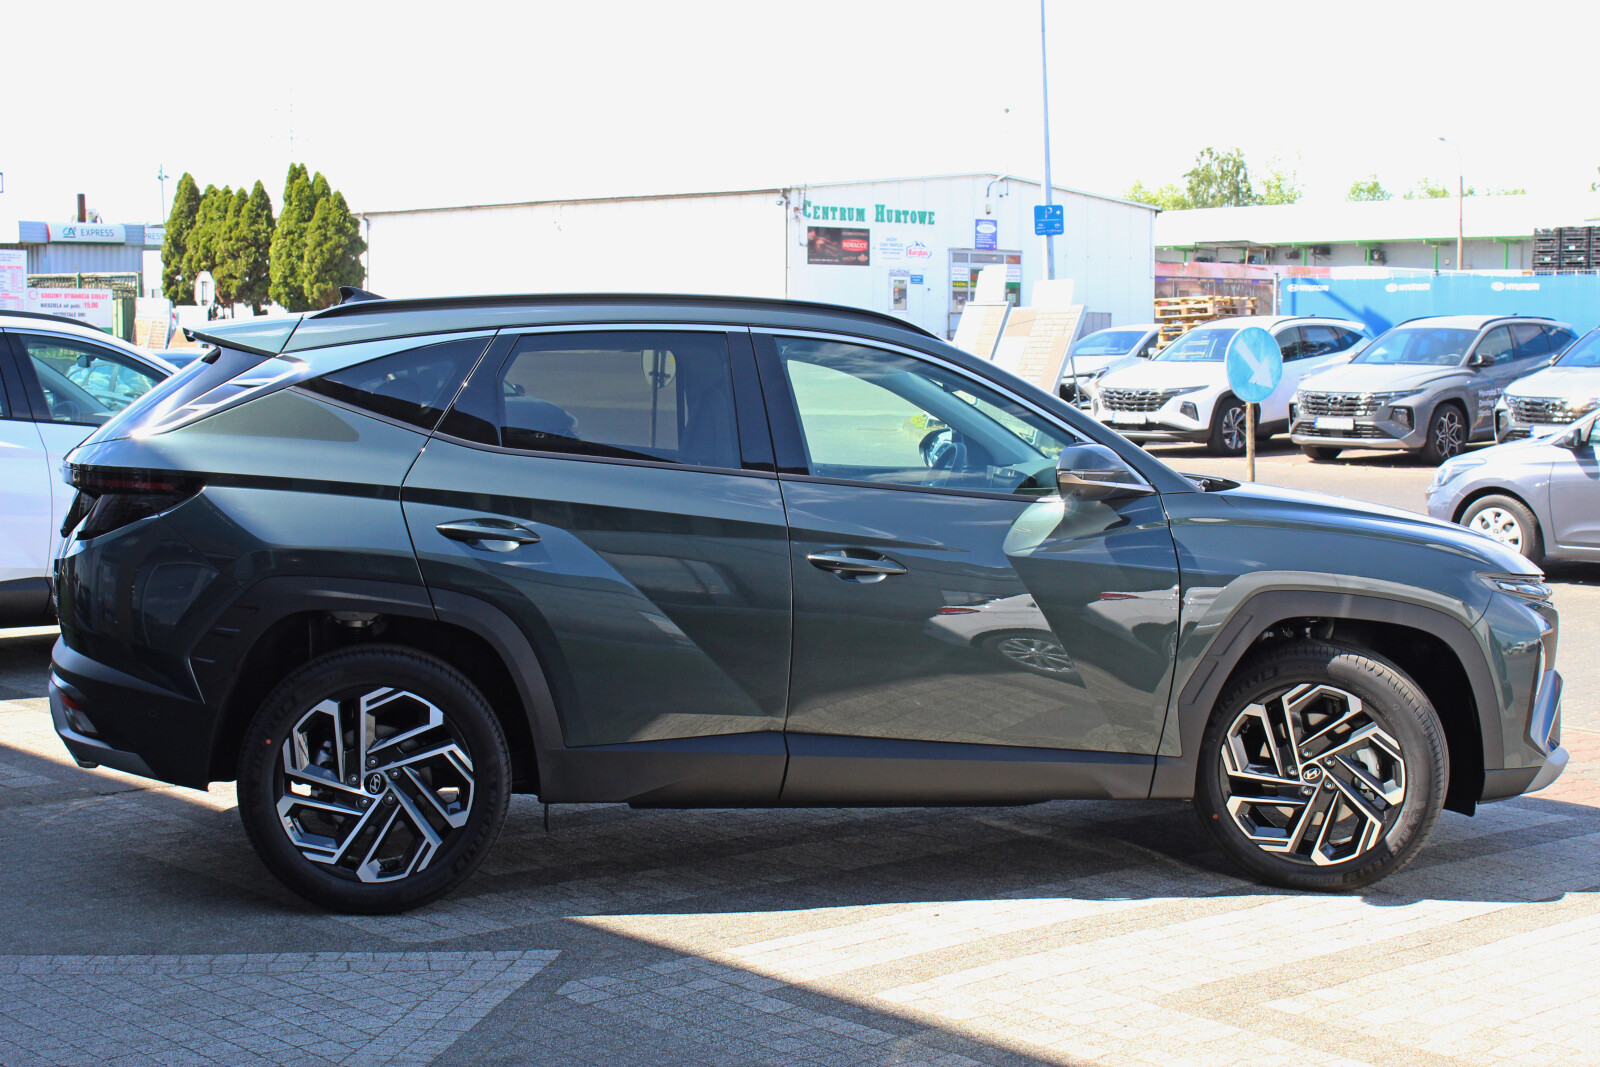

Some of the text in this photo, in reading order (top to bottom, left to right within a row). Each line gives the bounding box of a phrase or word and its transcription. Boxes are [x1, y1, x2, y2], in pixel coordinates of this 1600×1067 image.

[803, 200, 935, 225] CENTRUM HURTOWE
[80, 228, 115, 237] EXPRESS
[1299, 284, 1330, 292] HYUNDAI
[1505, 282, 1540, 291] HYUNDAI
[1478, 388, 1497, 397] Hyundai
[1478, 398, 1495, 408] Driving
